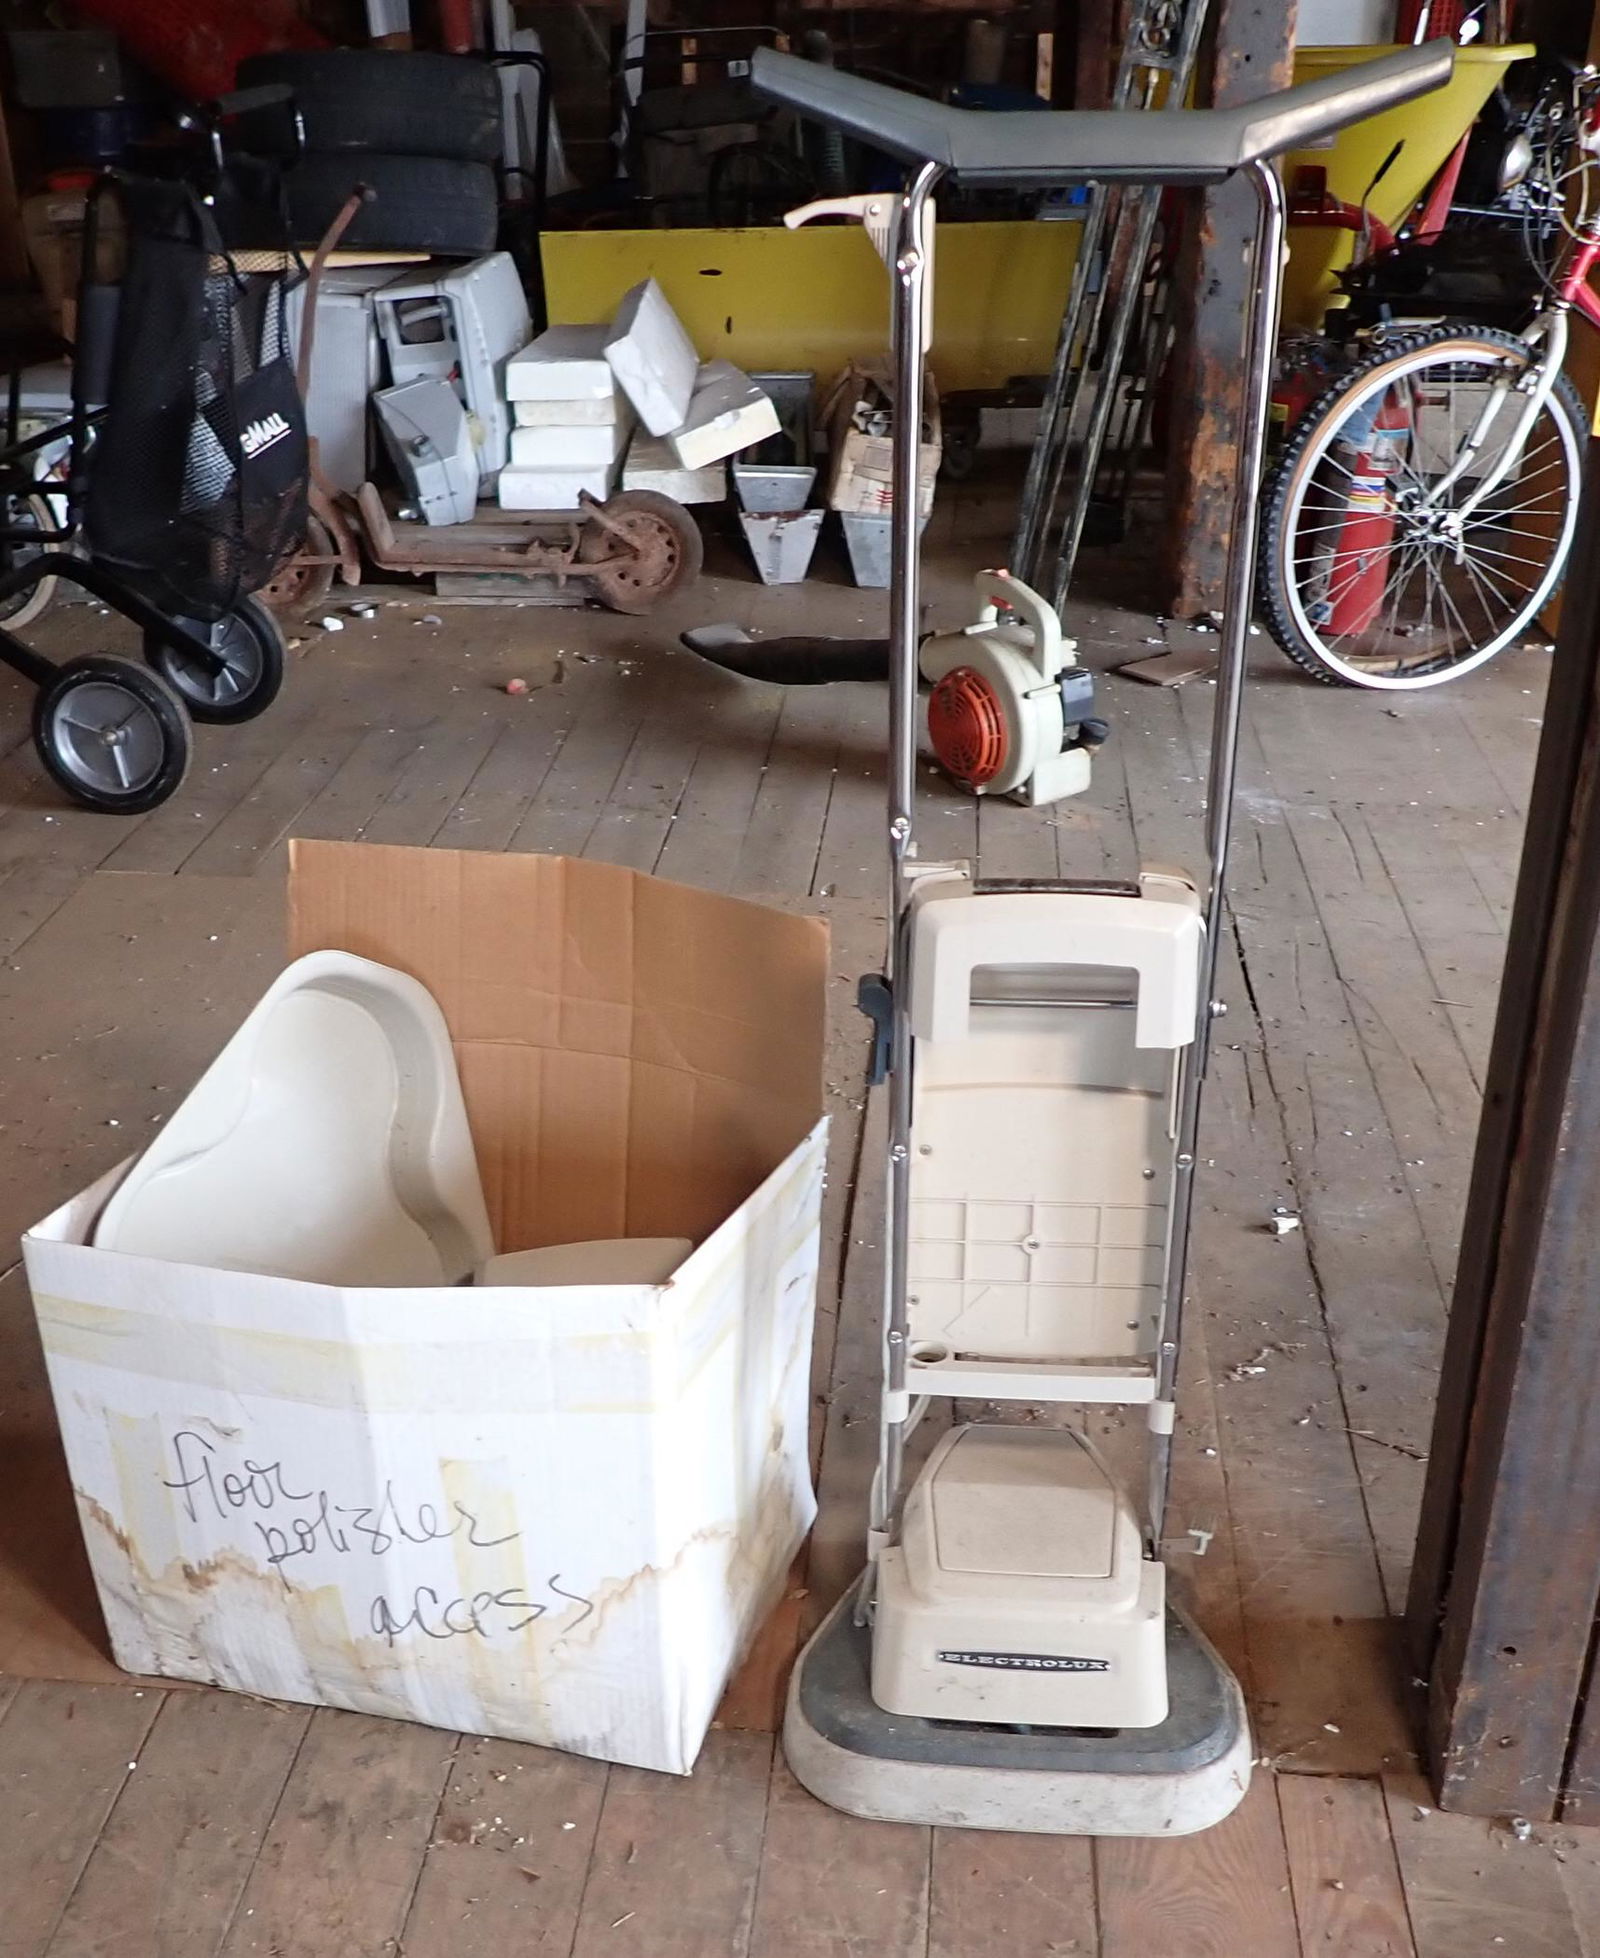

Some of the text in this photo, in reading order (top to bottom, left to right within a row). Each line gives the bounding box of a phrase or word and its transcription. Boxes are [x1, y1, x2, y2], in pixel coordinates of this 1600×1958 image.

[163, 1431, 314, 1523] floor
[255, 1480, 521, 1593] polisher
[944, 1652, 1105, 1671] ELECTROLUX
